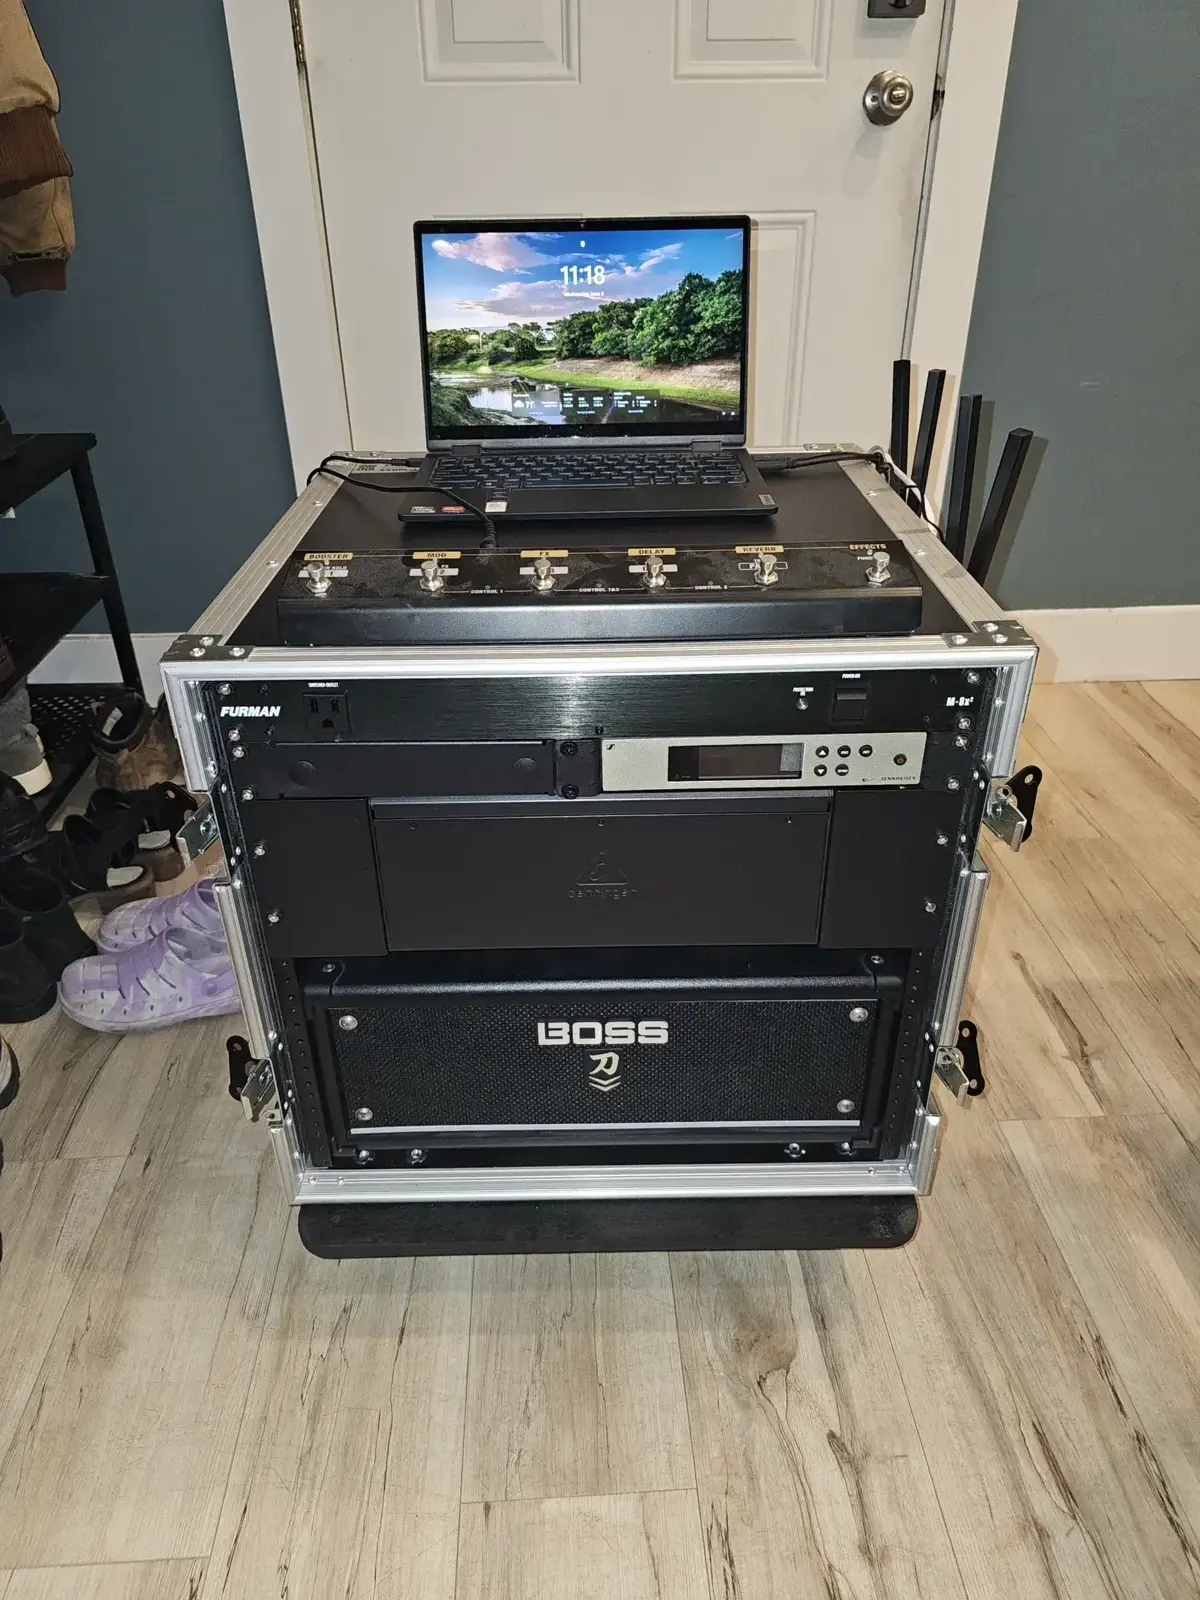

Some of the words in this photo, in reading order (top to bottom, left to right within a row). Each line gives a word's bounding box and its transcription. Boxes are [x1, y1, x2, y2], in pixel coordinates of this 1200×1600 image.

[560, 264, 606, 285] 11:18
[220, 706, 281, 718] FURMAN
[567, 887, 638, 900] behringer
[537, 1020, 669, 1046] BOSS
